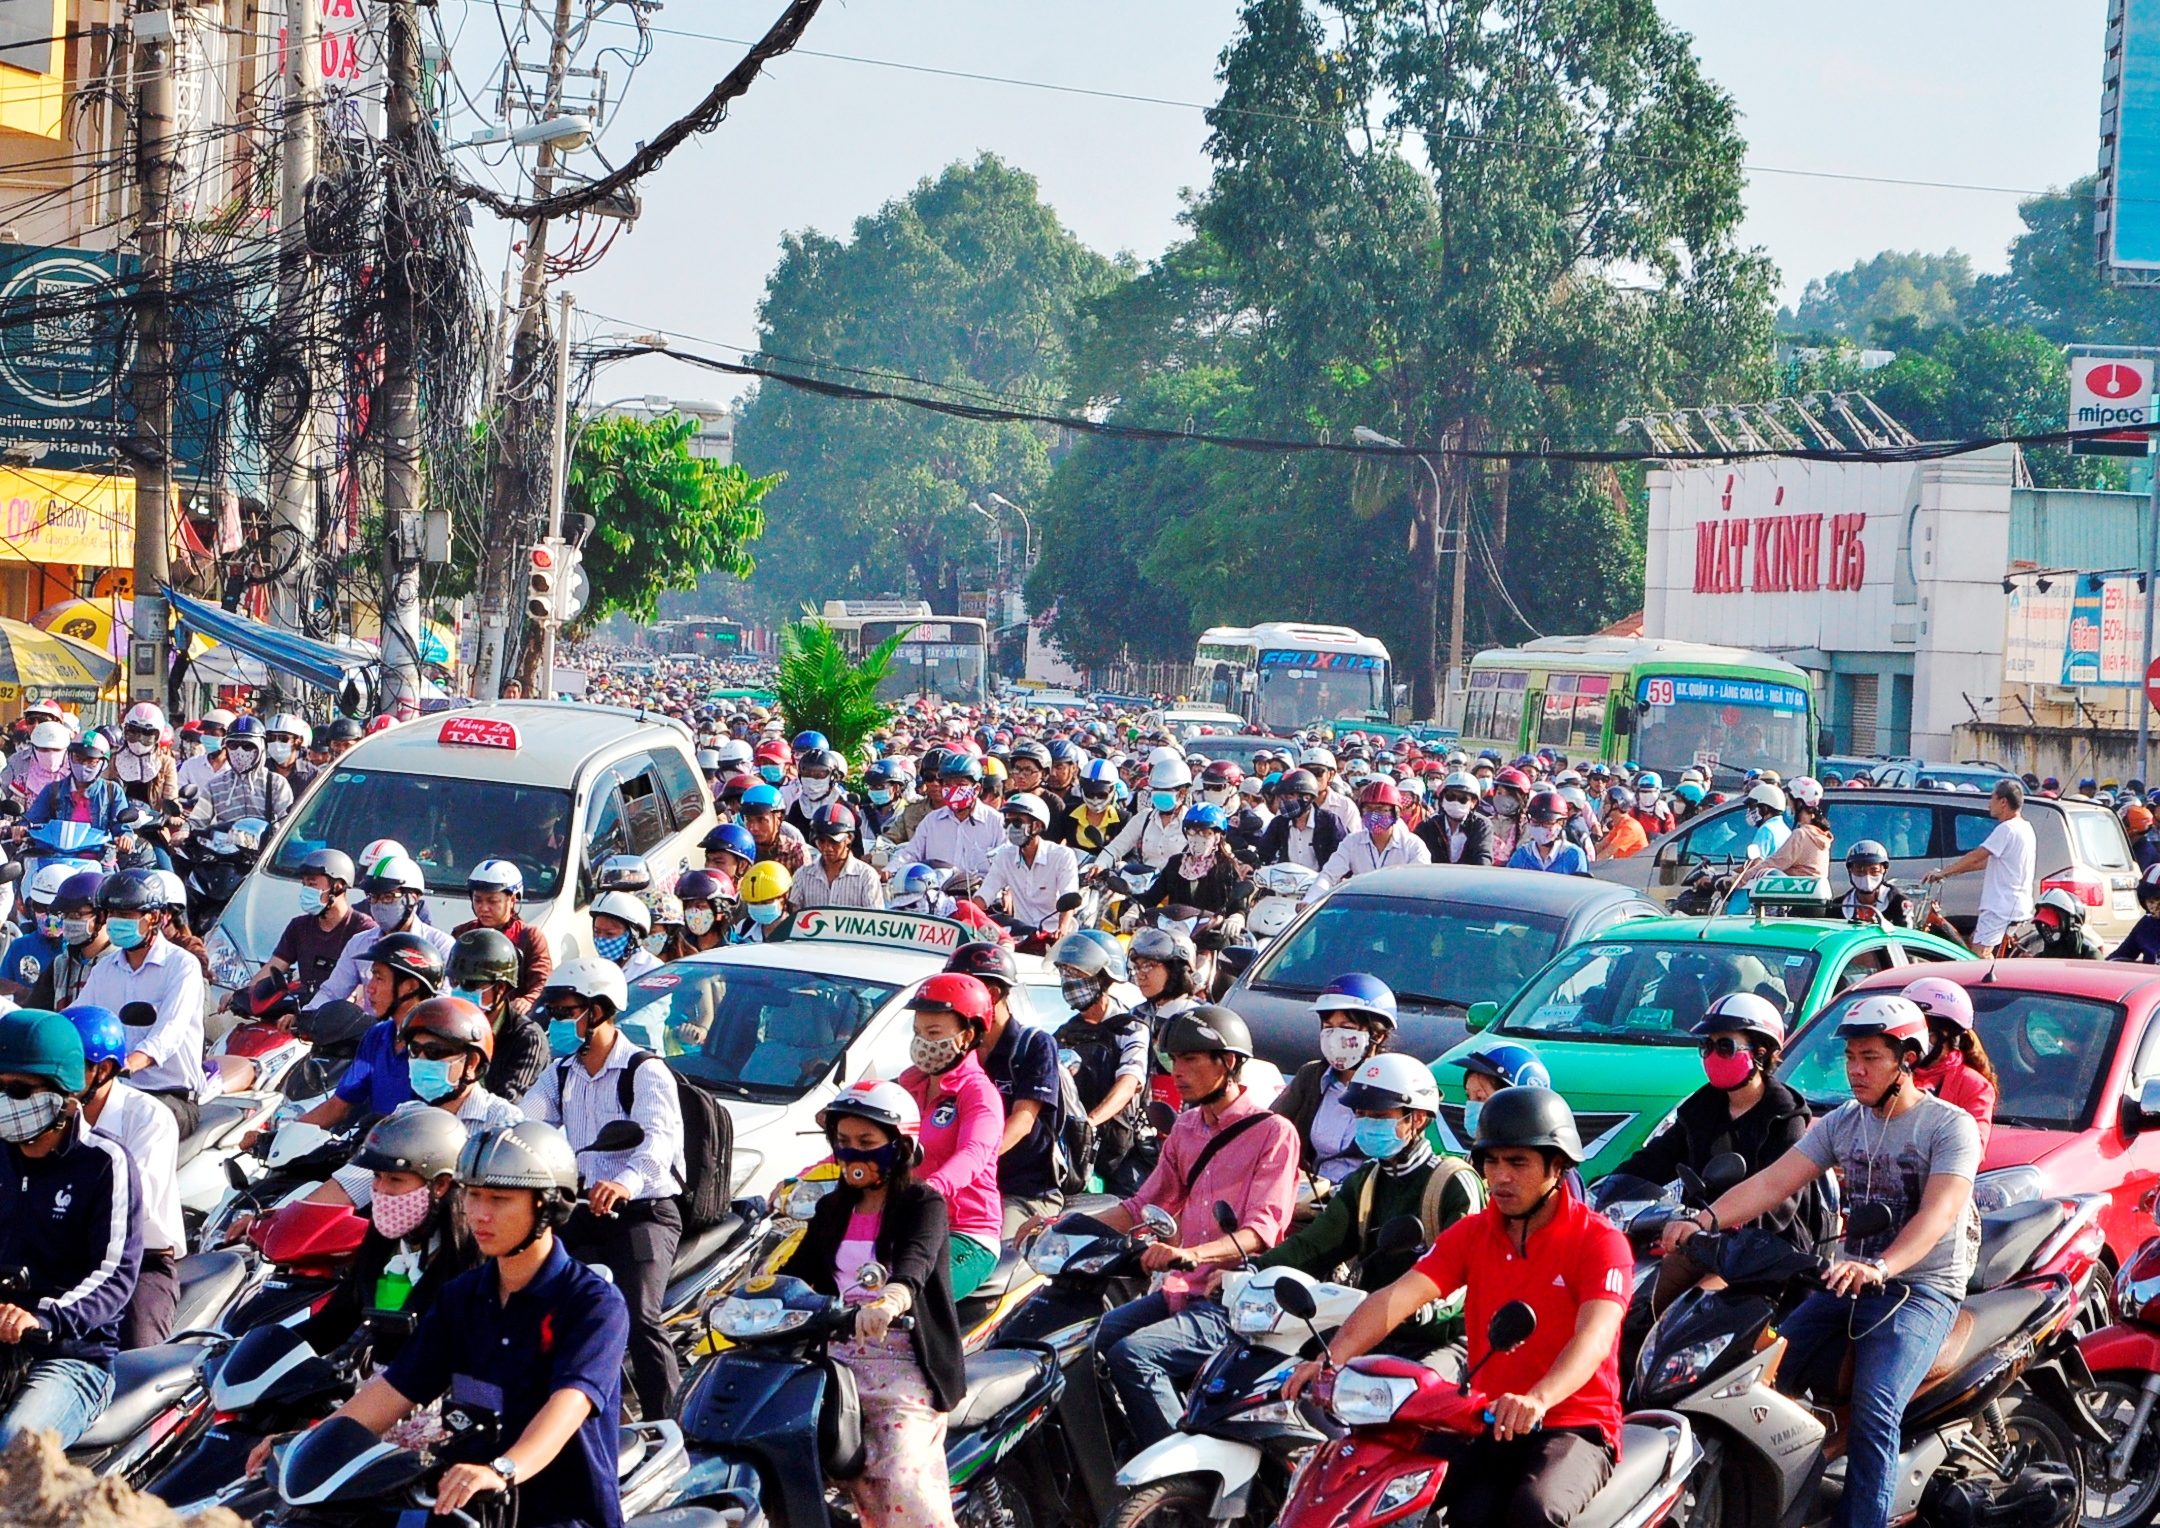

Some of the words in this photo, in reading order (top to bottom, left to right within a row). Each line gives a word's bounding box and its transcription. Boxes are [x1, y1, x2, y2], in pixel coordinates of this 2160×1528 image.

[2078, 403, 2144, 426] mipec
[46, 499, 89, 535] Galaxy
[99, 503, 131, 533] Lumia
[1751, 486, 1823, 592] KÍNH
[1826, 512, 1866, 592] 175
[917, 625, 931, 640] 148
[2103, 619, 2124, 641] 50%
[1649, 681, 1673, 704] 59
[447, 730, 510, 747] TAXI
[1760, 878, 1818, 892] TAXI
